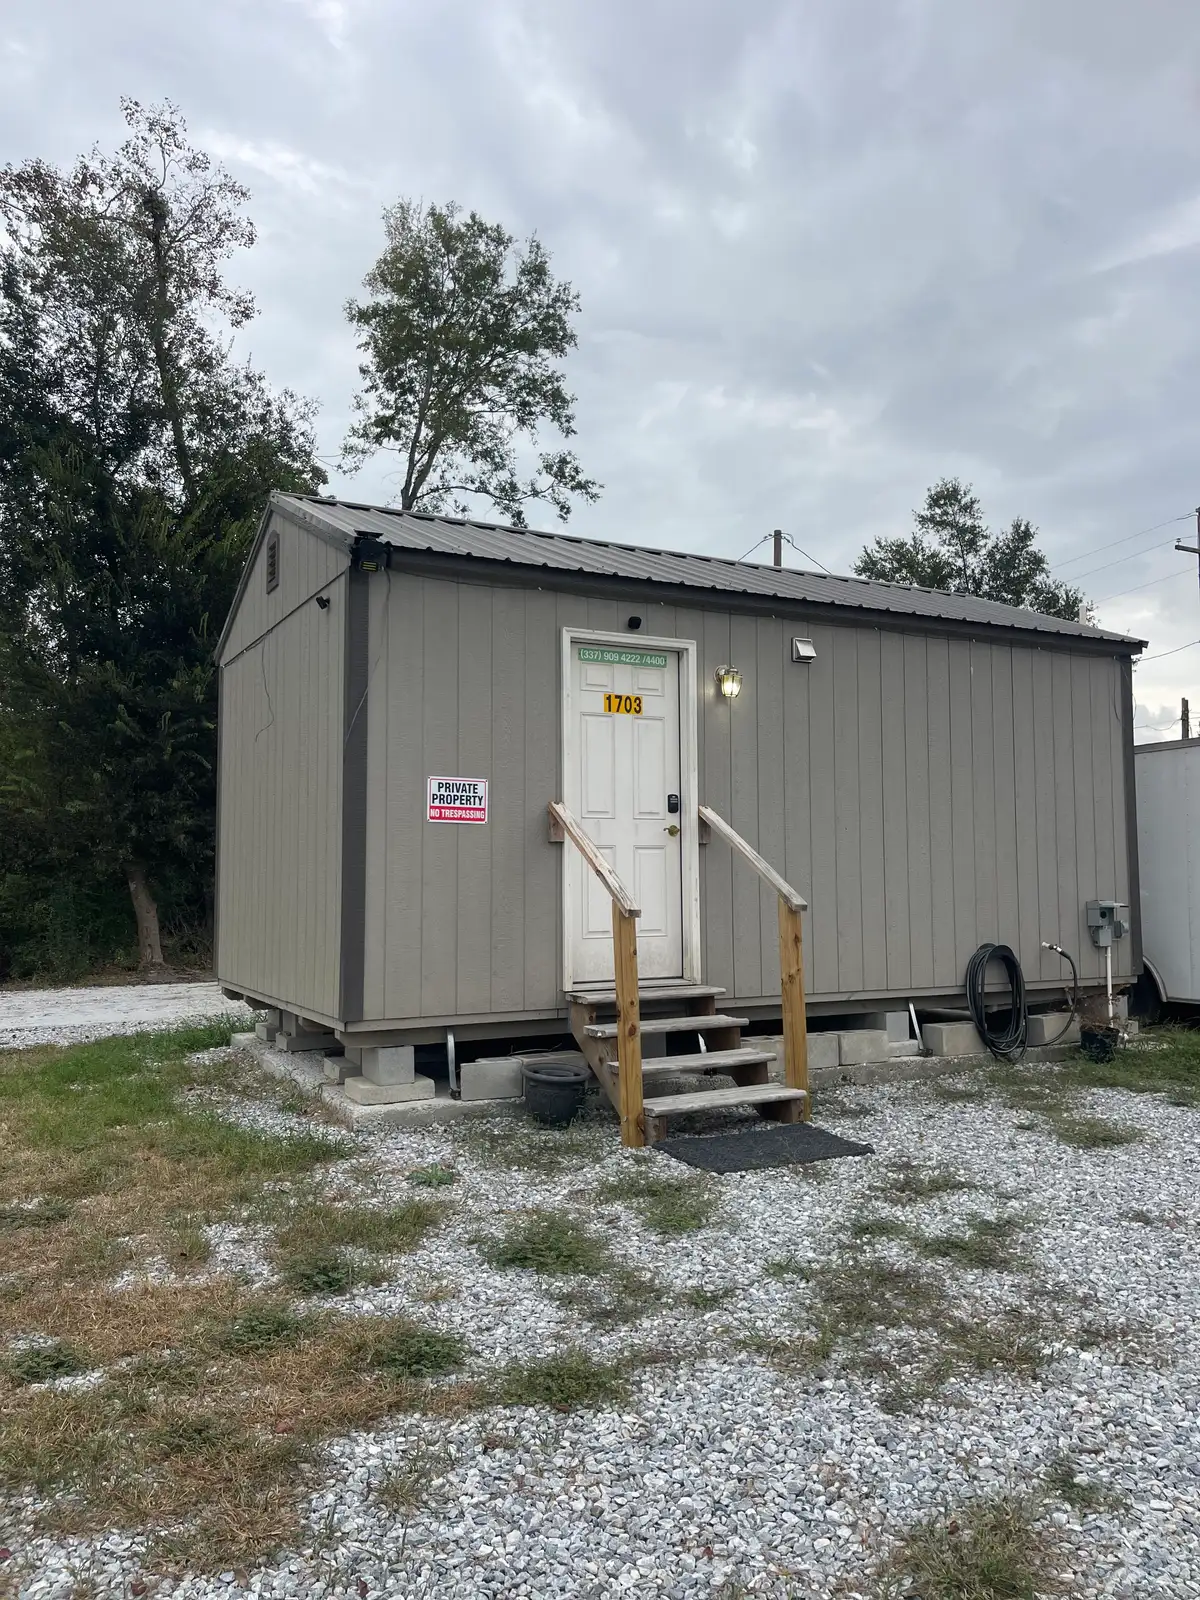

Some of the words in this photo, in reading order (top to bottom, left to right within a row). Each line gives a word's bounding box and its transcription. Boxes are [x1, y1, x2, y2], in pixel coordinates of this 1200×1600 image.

[580, 648, 601, 660] (337)
[603, 651, 619, 661] 909
[620, 653, 641, 663] 4222
[642, 655, 665, 666] /4400
[605, 694, 642, 714] 1703
[437, 782, 478, 794] PRIVATE
[432, 793, 484, 806] PROPERTY
[430, 808, 440, 818] NO
[441, 809, 485, 819] TRESPASSING
